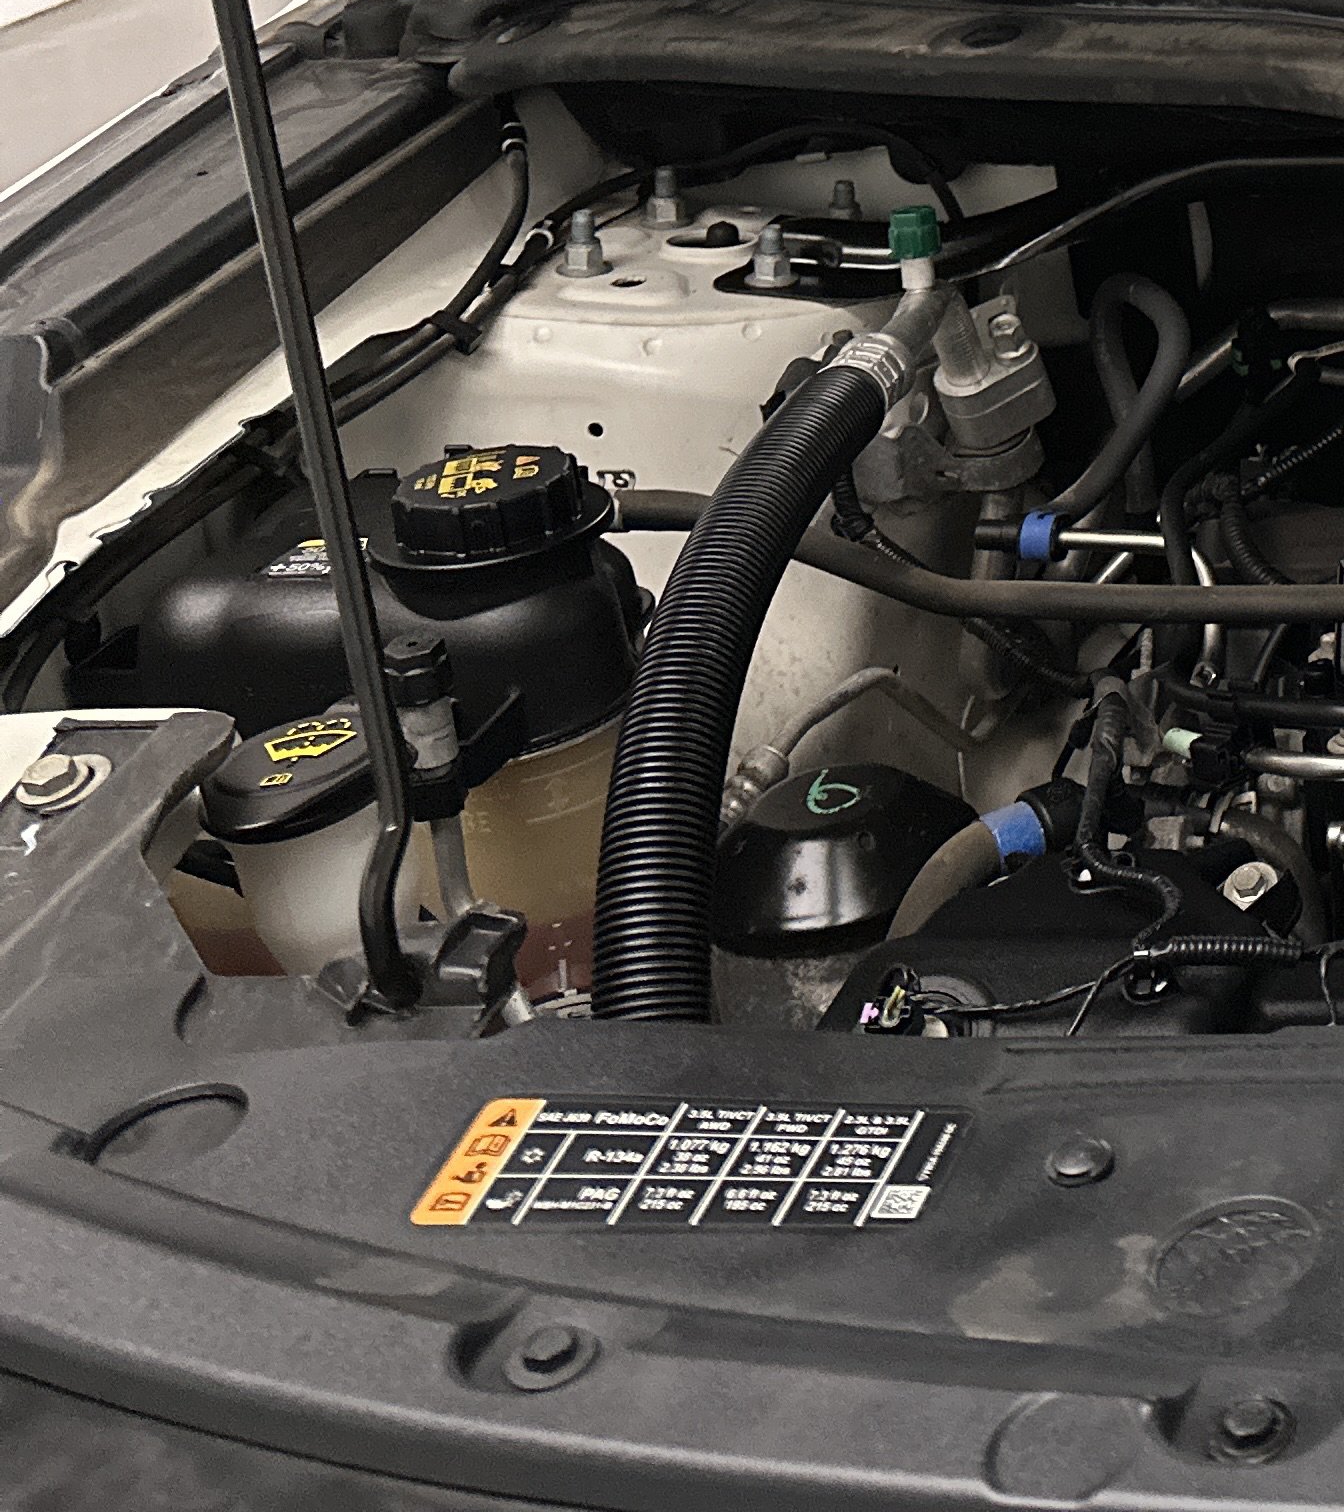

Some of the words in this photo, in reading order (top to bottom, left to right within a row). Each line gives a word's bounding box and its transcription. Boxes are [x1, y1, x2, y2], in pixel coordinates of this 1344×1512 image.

[594, 1112, 670, 1126] FoMoCo
[697, 1121, 731, 1131] AWD
[668, 1139, 709, 1151] 1.077
[709, 1140, 731, 1154] kg
[750, 1141, 791, 1153] 1.162
[791, 1142, 812, 1156] kg
[829, 1143, 871, 1155] 1.276
[871, 1144, 892, 1159] kg
[583, 1148, 645, 1164] R-134a
[577, 1187, 621, 1201] PAG
